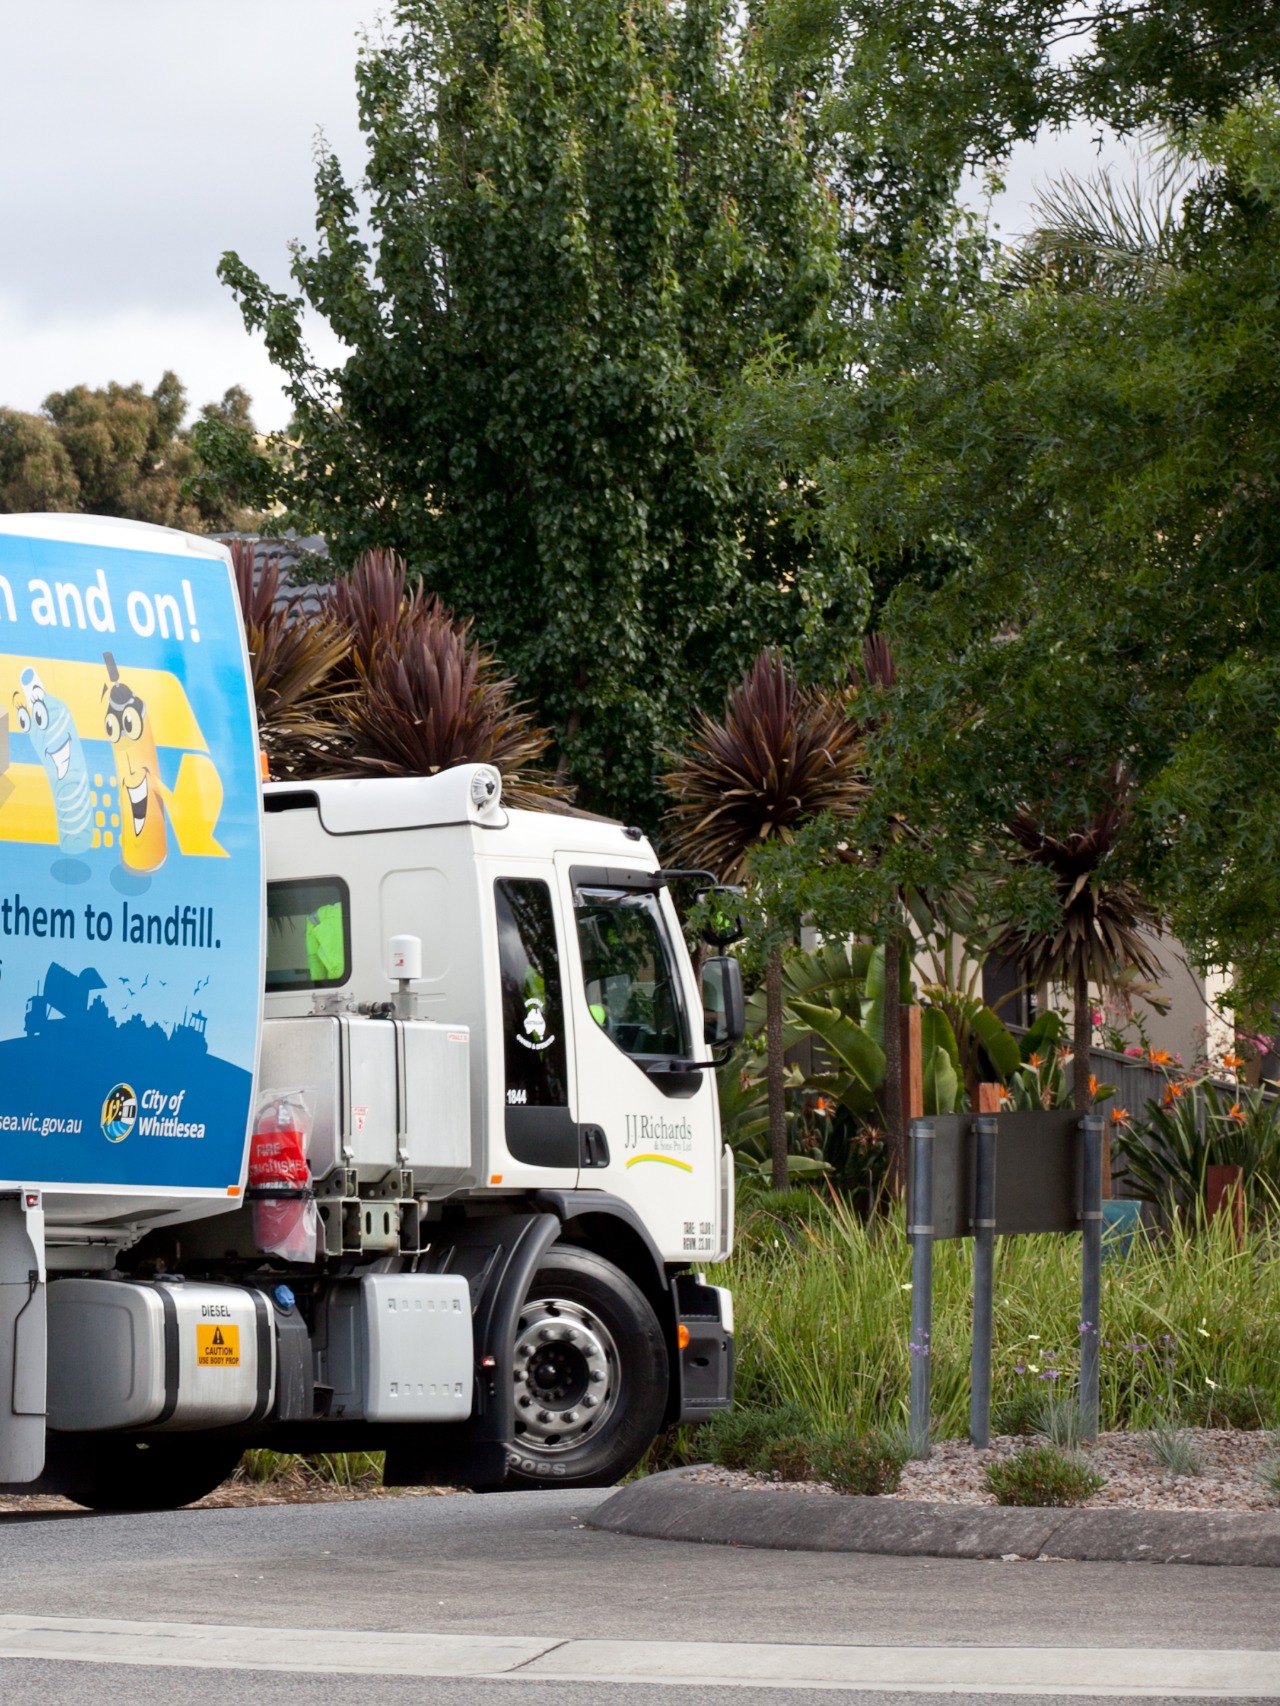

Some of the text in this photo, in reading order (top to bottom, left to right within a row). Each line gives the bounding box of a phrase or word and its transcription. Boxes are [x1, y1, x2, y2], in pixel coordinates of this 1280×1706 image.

[28, 569, 115, 632] and
[127, 580, 200, 642] on!
[1, 894, 74, 939] them
[85, 904, 112, 941] to
[123, 902, 220, 948] landfill.
[141, 1090, 186, 1116] City of
[507, 1089, 527, 1104] 1844
[139, 1117, 205, 1138] Whittlesea
[640, 1115, 692, 1140] Richards
[256, 1142, 281, 1157] FIRE
[201, 1305, 231, 1317] DIESEL
[205, 1347, 233, 1355] CAUTION
[210, 1357, 224, 1365] BODY
[226, 1357, 239, 1365] PROP
